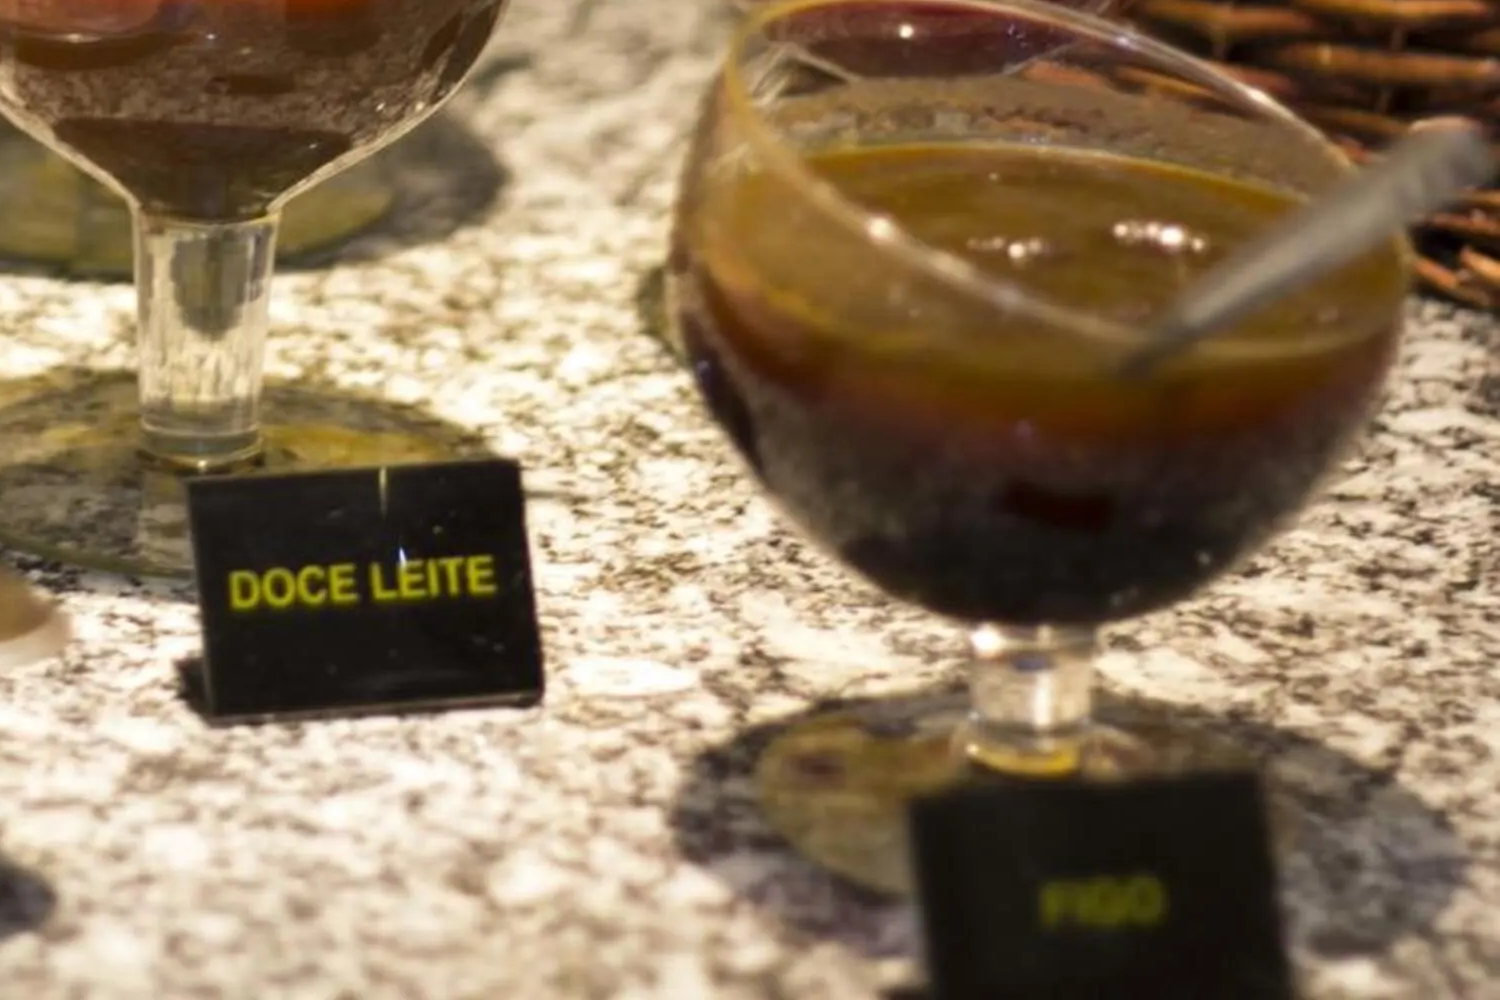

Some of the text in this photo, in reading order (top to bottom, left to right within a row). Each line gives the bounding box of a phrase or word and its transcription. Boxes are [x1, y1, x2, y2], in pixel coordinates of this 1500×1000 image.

[228, 555, 497, 611] DOCE LEITE
[1041, 877, 1164, 926] FIGO
